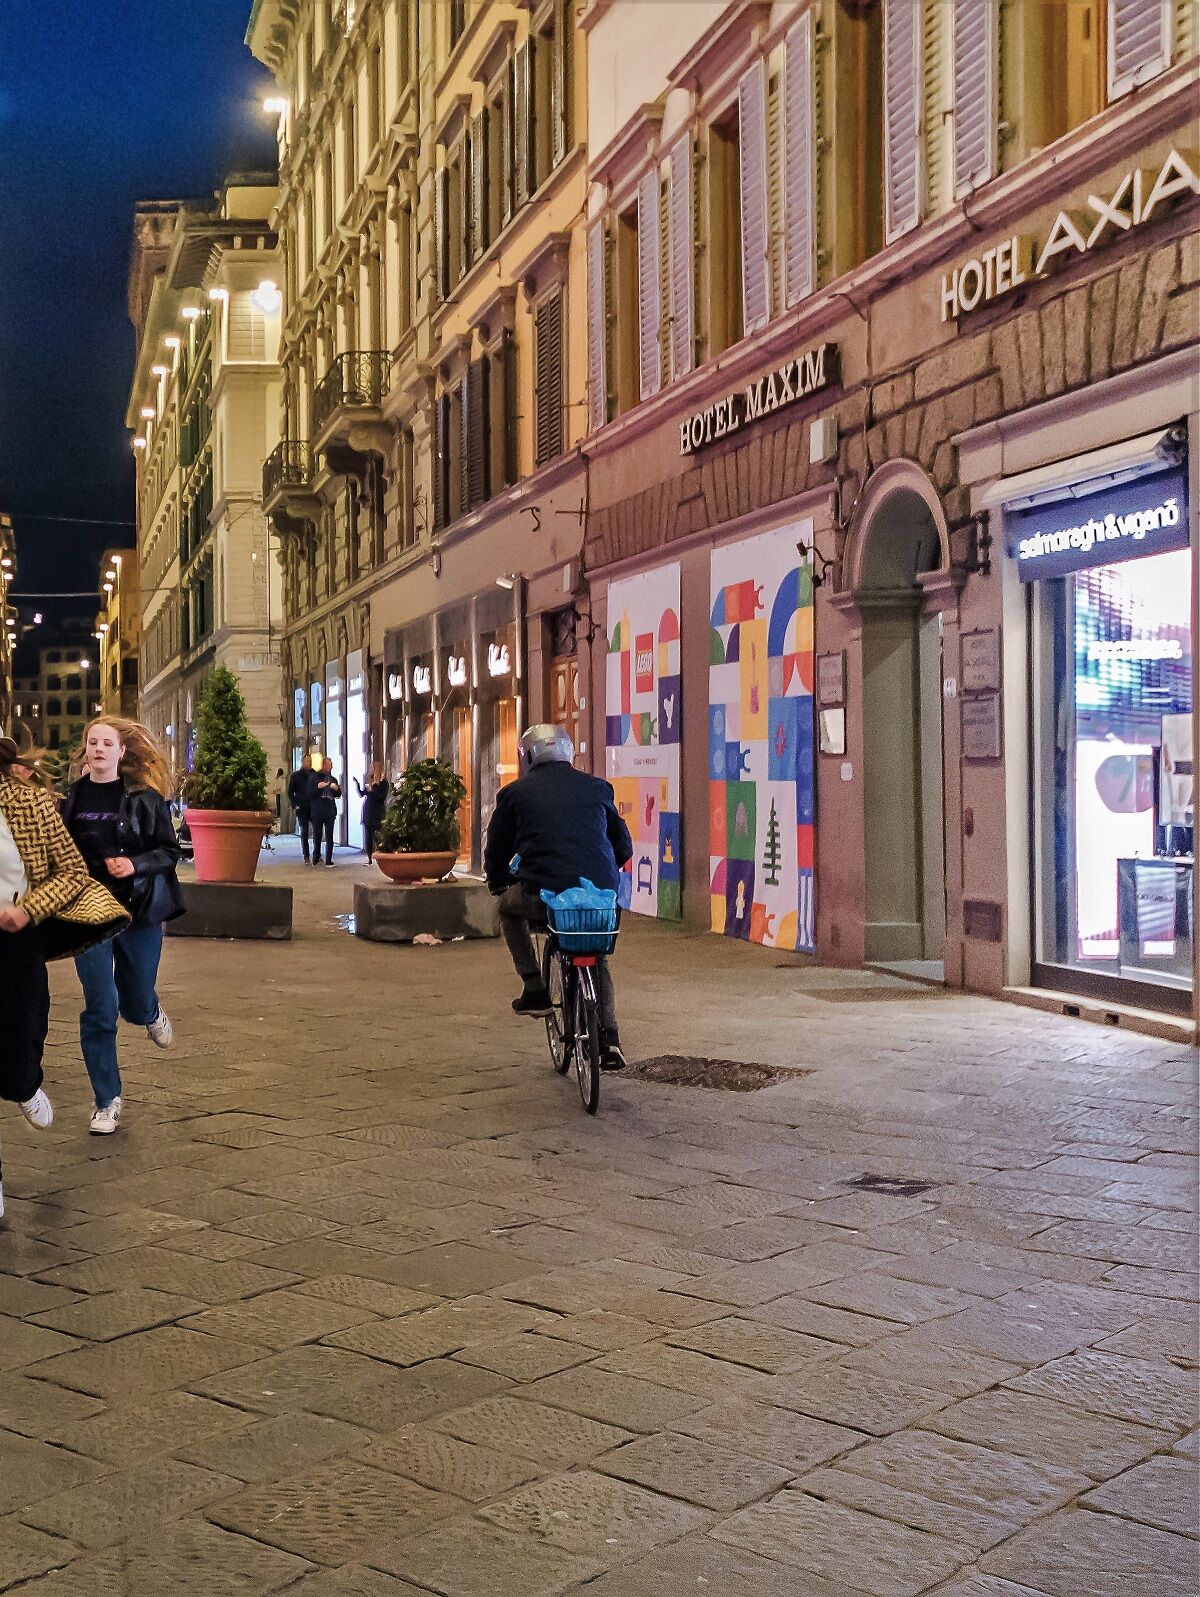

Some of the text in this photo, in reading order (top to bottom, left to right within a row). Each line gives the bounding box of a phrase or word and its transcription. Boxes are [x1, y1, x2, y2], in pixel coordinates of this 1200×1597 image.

[941, 235, 1025, 322] HOTEL
[679, 342, 828, 456] HOTEL MAXIM
[637, 653, 652, 674] LEGO
